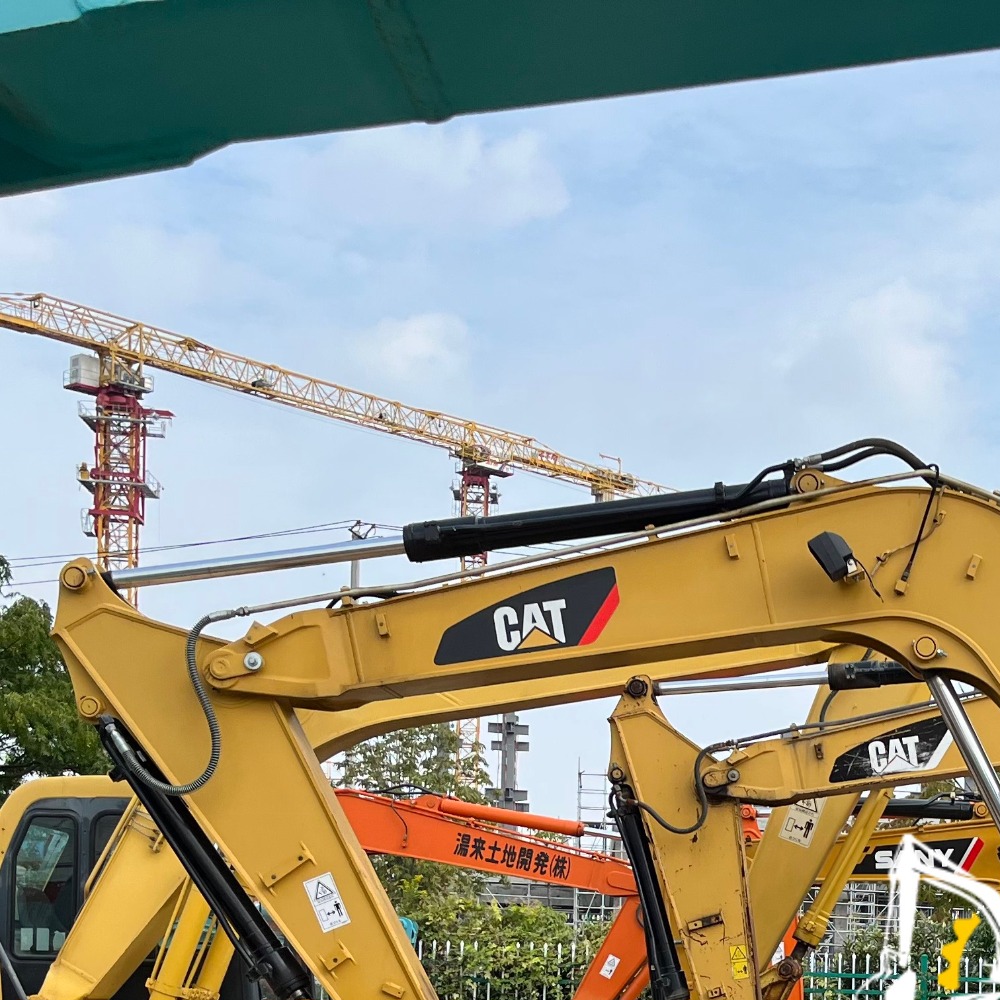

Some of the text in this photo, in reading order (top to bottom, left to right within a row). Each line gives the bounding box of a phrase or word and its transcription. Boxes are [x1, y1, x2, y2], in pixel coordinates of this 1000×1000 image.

[493, 598, 567, 652] CAT
[868, 735, 919, 774] CAT
[453, 832, 571, 880] 湯来土地開発(株)
[874, 848, 954, 870] SNY
